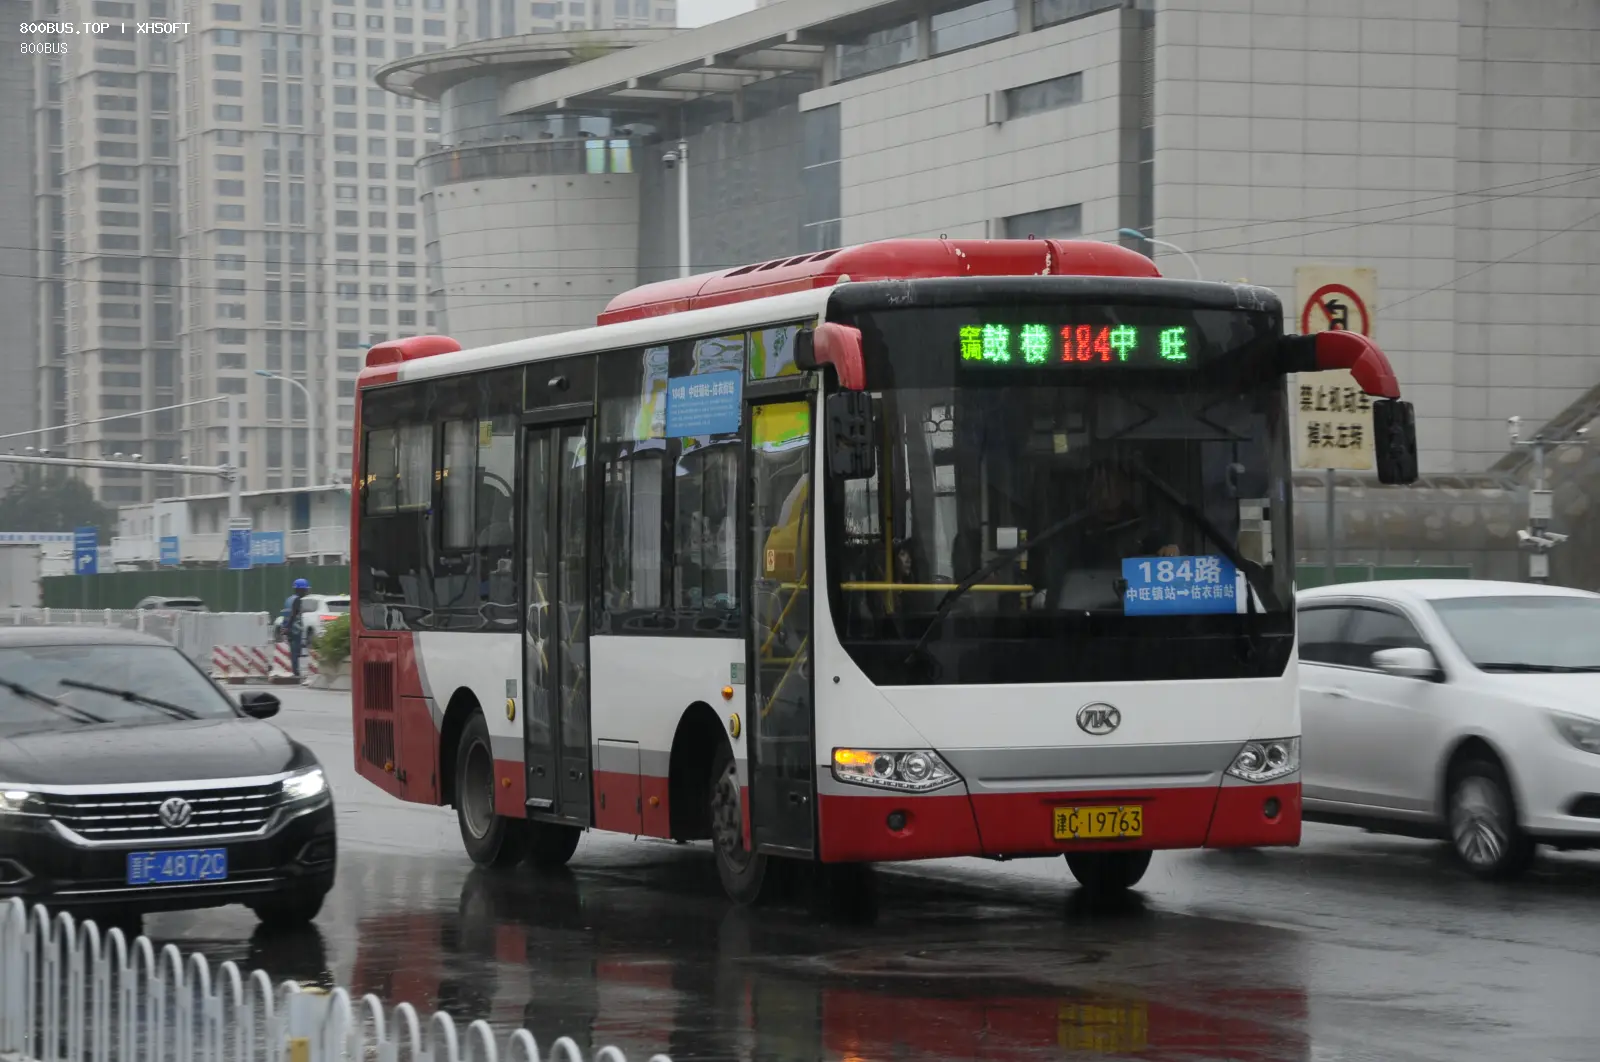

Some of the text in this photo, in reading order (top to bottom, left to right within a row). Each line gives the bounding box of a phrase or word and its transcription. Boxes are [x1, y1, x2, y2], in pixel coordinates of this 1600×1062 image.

[959, 325, 982, 360] 空调
[1060, 324, 1110, 361] 184
[1138, 556, 1222, 583] 184路
